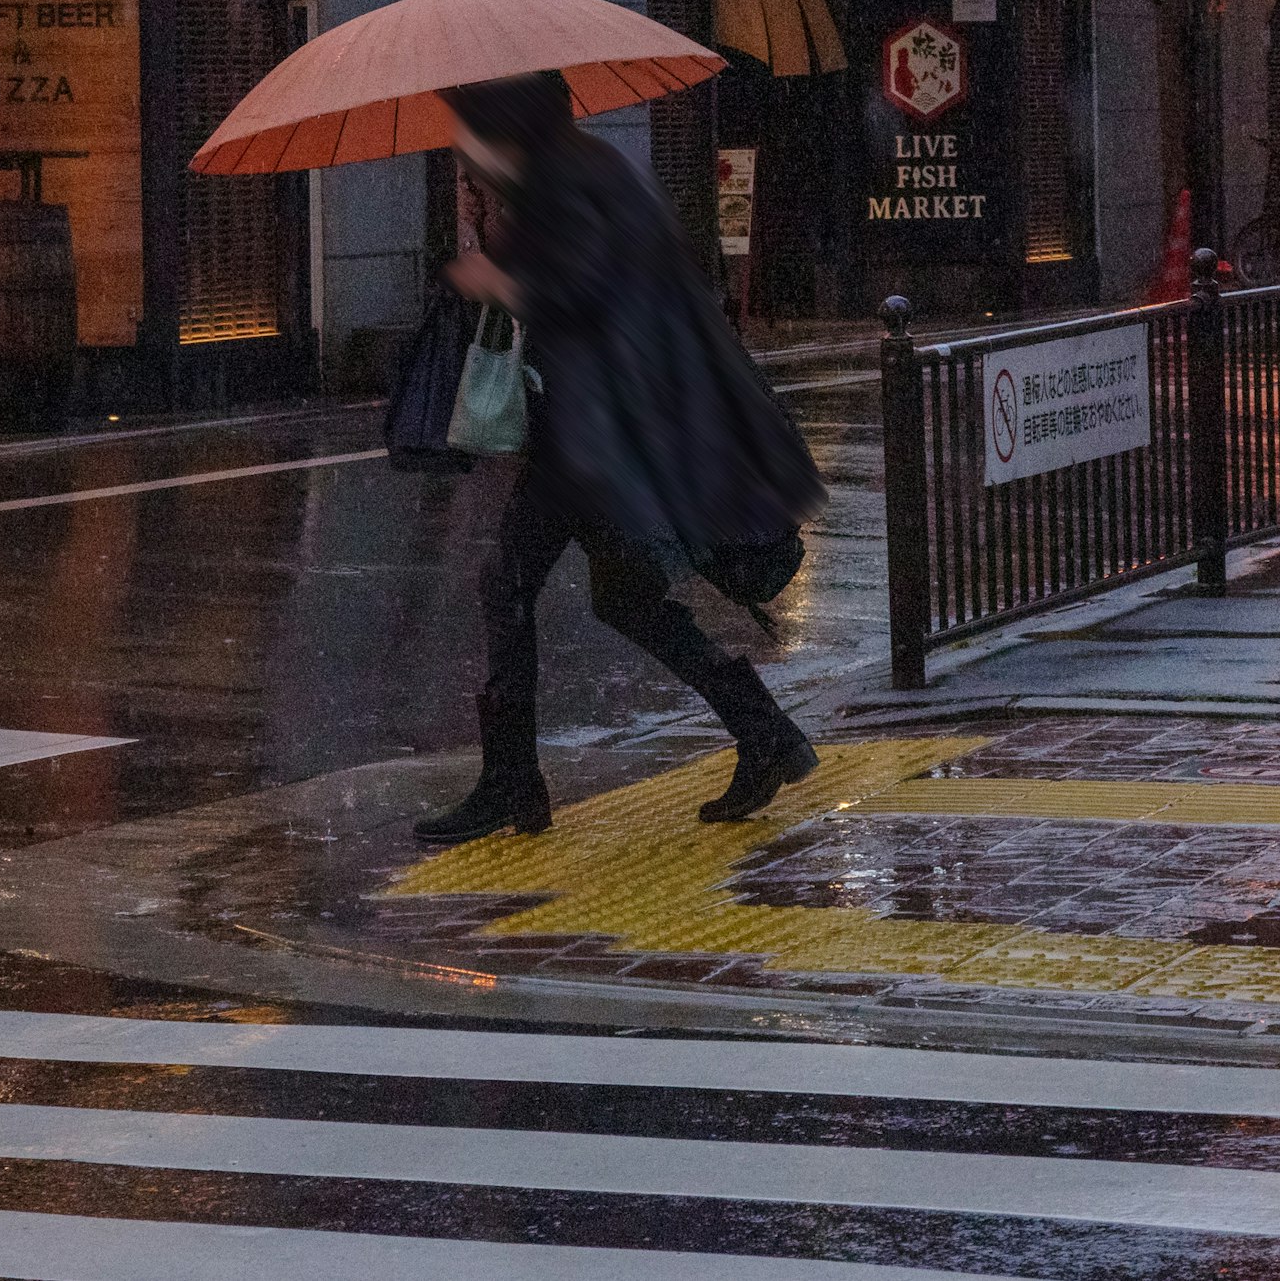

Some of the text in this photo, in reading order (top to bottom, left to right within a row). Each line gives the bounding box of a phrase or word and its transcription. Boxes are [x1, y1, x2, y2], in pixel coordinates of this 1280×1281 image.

[36, 2, 114, 29] BEER
[895, 134, 959, 158] LIVE
[897, 165, 958, 188] FISH
[868, 195, 987, 220] MARKET
